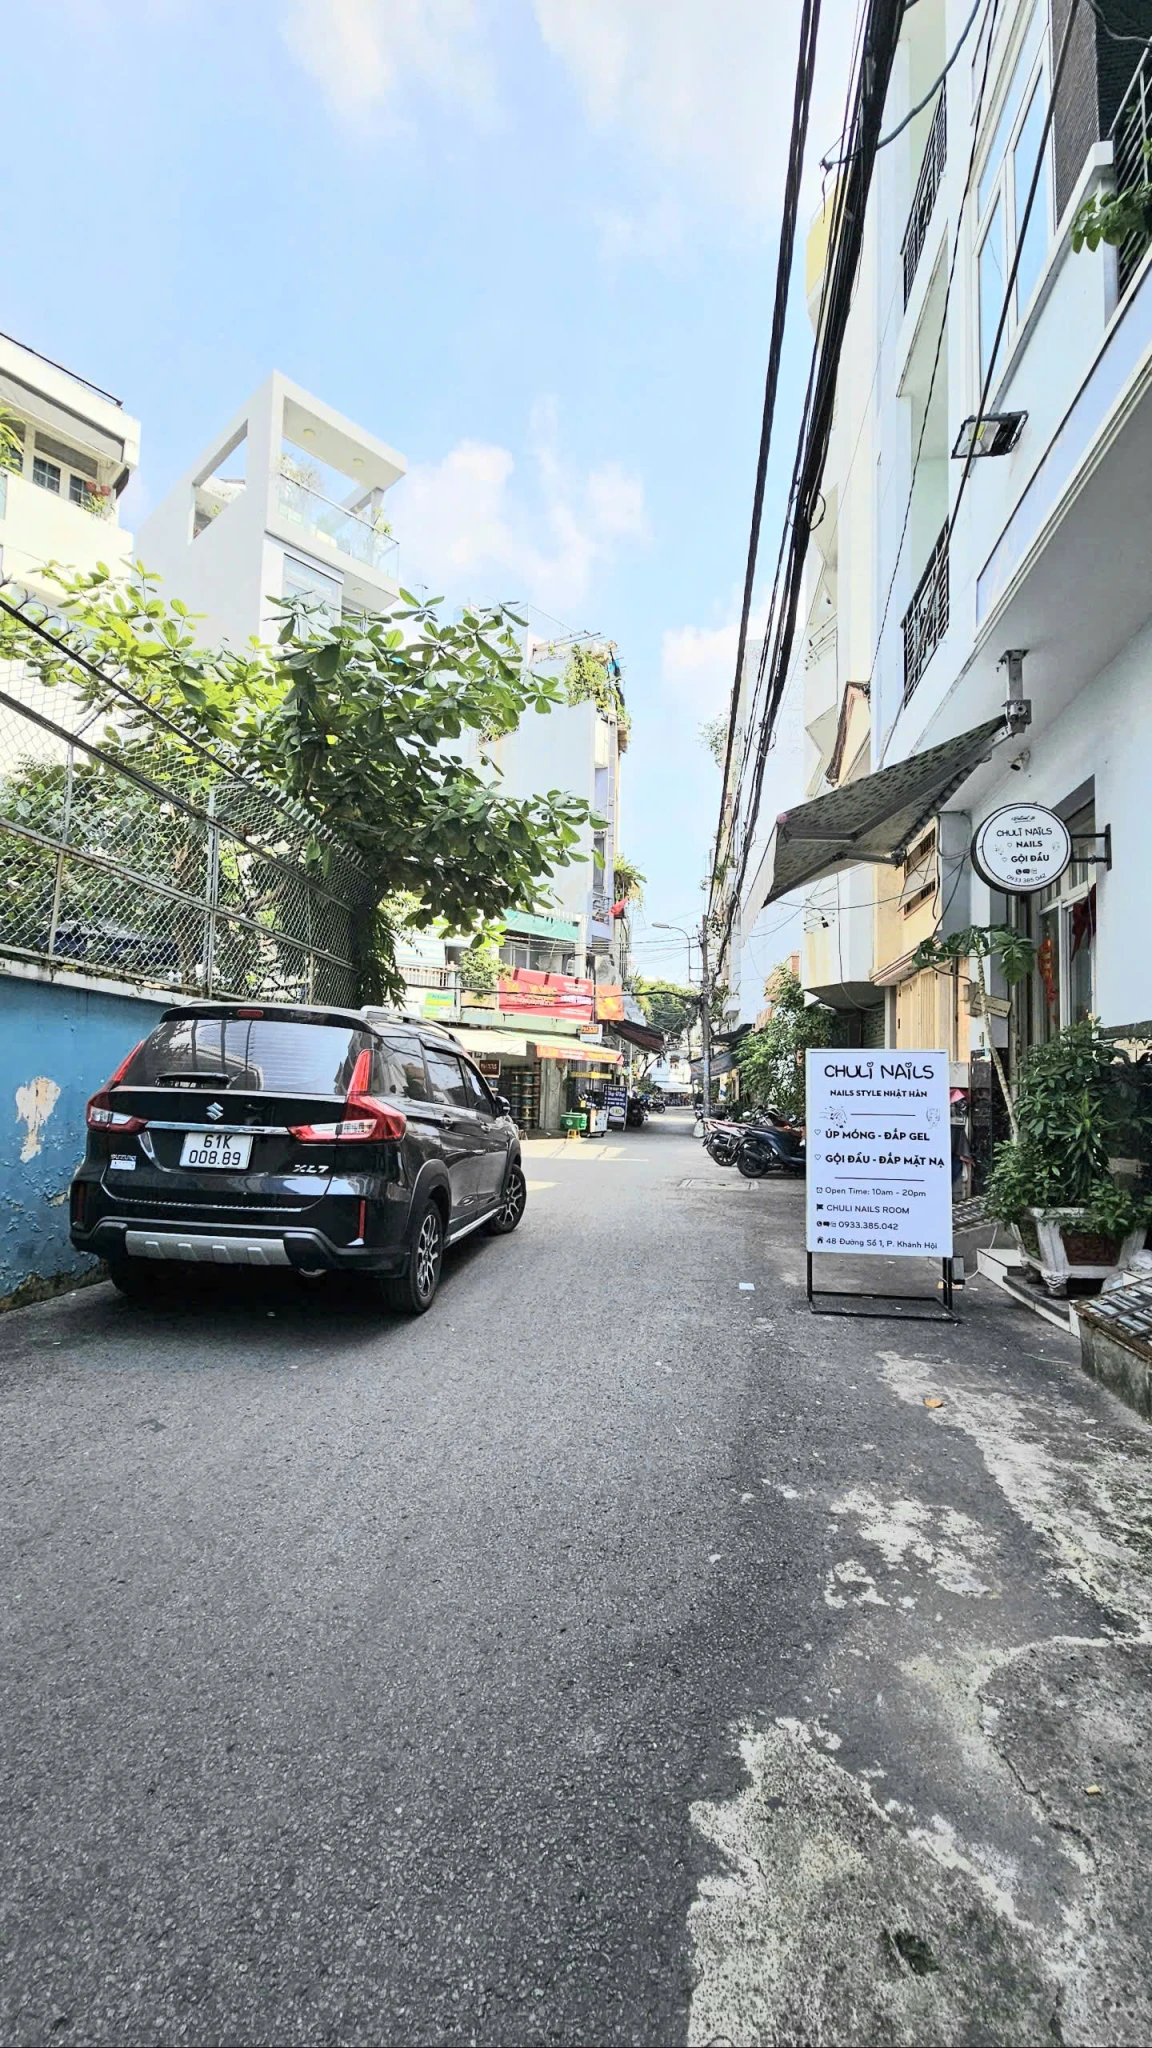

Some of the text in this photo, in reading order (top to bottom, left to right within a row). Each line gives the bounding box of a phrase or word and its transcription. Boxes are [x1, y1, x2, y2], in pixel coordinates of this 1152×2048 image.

[1016, 840, 1043, 848] NAILS
[1011, 853, 1028, 864] GỘI
[825, 1128, 840, 1139] ÚP
[842, 1128, 876, 1139] MÓNG
[884, 1127, 907, 1141] ĐẮP
[909, 1132, 931, 1141] GEL
[203, 1134, 230, 1149] 61K
[188, 1150, 241, 1166] 008.89
[825, 1152, 845, 1165] GỘI
[879, 1152, 901, 1164] ĐẮP
[903, 1155, 926, 1168] MẶT
[928, 1157, 945, 1169] NẠ
[291, 1164, 330, 1173] XL7
[825, 1187, 846, 1196] Open
[848, 1187, 870, 1195] Time:
[872, 1188, 894, 1196] 10am
[902, 1189, 927, 1198] 20pm
[826, 1204, 910, 1214] CHULI NAILS ROOM
[838, 1221, 899, 1231] 0933.385.042
[826, 1237, 837, 1245] 48
[839, 1237, 865, 1248] Đường
[866, 1239, 877, 1247] Số
[879, 1239, 885, 1248] 1,
[886, 1240, 895, 1248] P.
[924, 1241, 938, 1250] Hội
